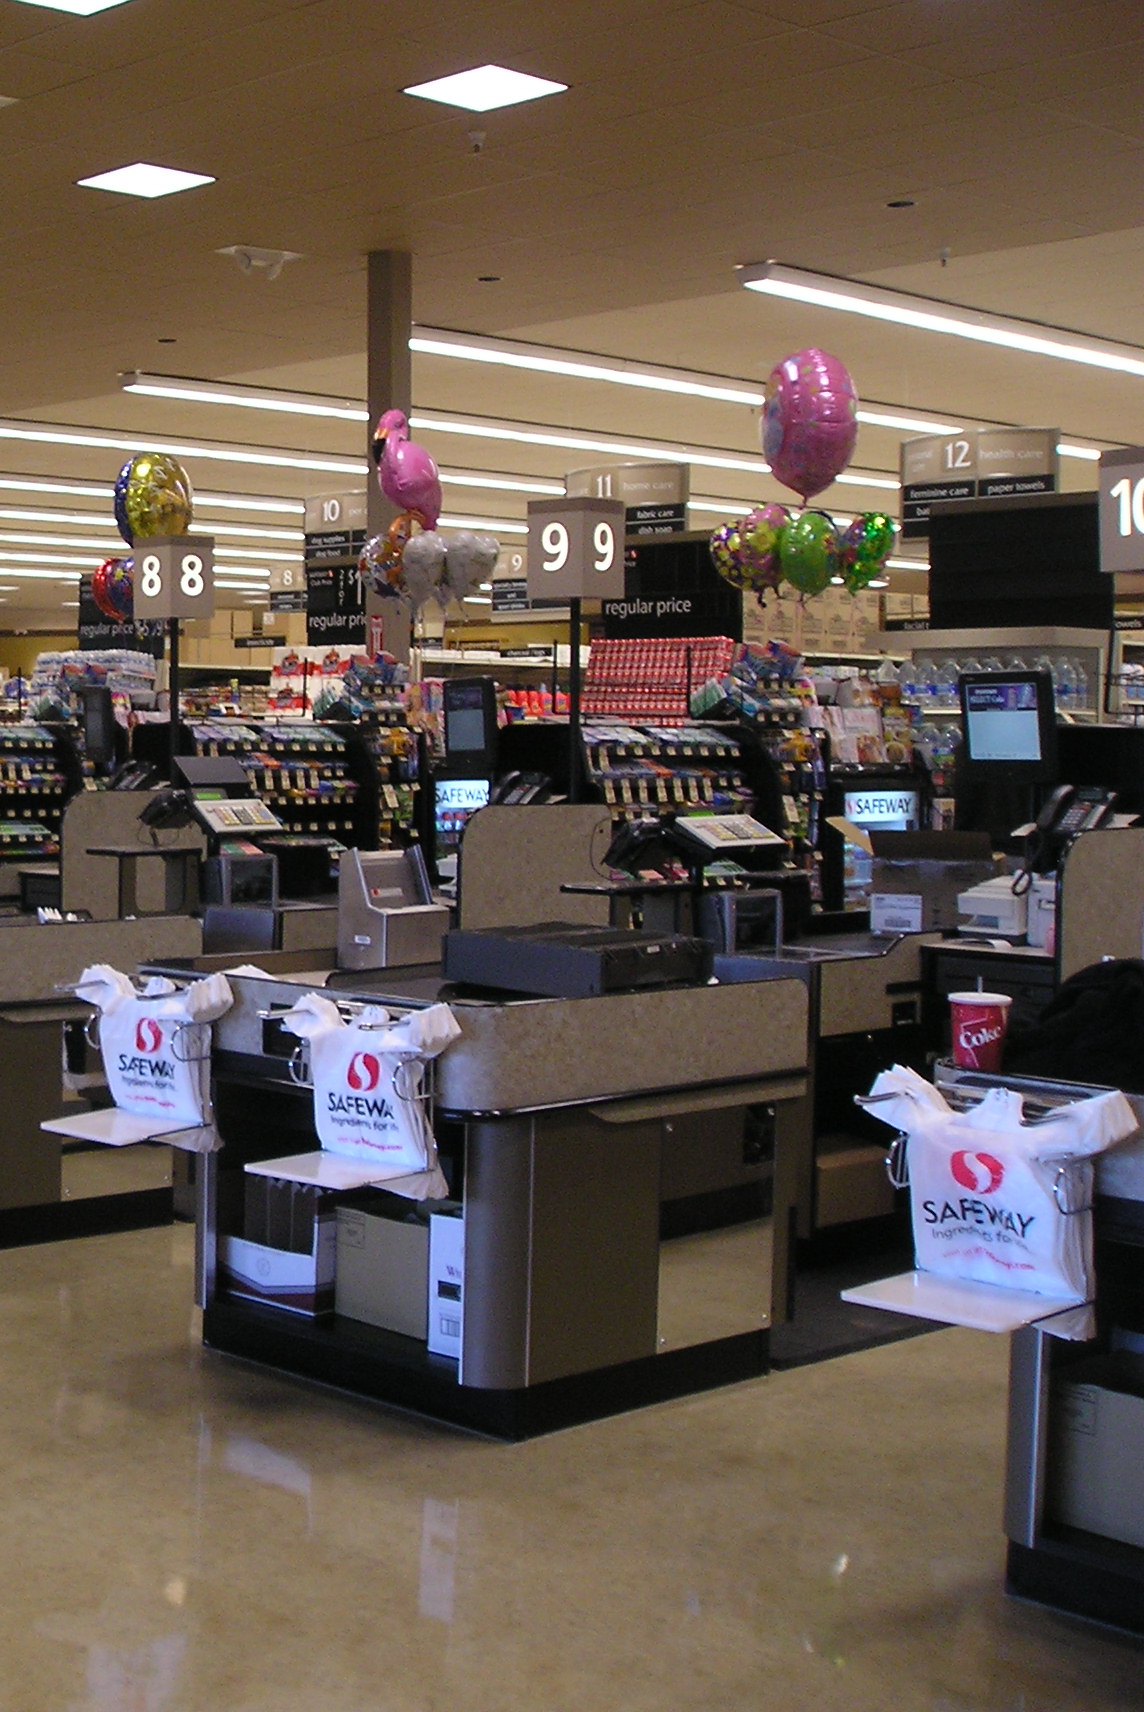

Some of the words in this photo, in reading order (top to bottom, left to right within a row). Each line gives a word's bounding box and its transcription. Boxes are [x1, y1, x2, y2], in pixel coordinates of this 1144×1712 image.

[945, 441, 971, 469] 12
[979, 449, 1014, 460] health
[1018, 450, 1044, 459] care
[597, 474, 612, 498] 11
[623, 482, 650, 491] home
[910, 487, 948, 501] feminine
[949, 486, 969, 496] care
[987, 484, 1013, 496] paper
[1015, 481, 1044, 492] towels
[323, 499, 340, 521] 10
[636, 511, 657, 519] fabric
[658, 509, 674, 517] care
[638, 527, 653, 535] dish
[541, 522, 569, 572] 9
[593, 522, 615, 571] 9
[512, 554, 523, 572] 9
[141, 554, 162, 597] 8
[180, 553, 204, 597] 8
[283, 570, 293, 586] 8
[605, 598, 654, 619] regular
[656, 597, 692, 618] price
[80, 622, 110, 639] regular
[309, 612, 346, 631] regular
[434, 787, 490, 803] SAFEWAY
[856, 798, 912, 814] SAFEWAY
[959, 1026, 1002, 1049] Coke
[922, 1198, 1035, 1238] SAFEWAY
